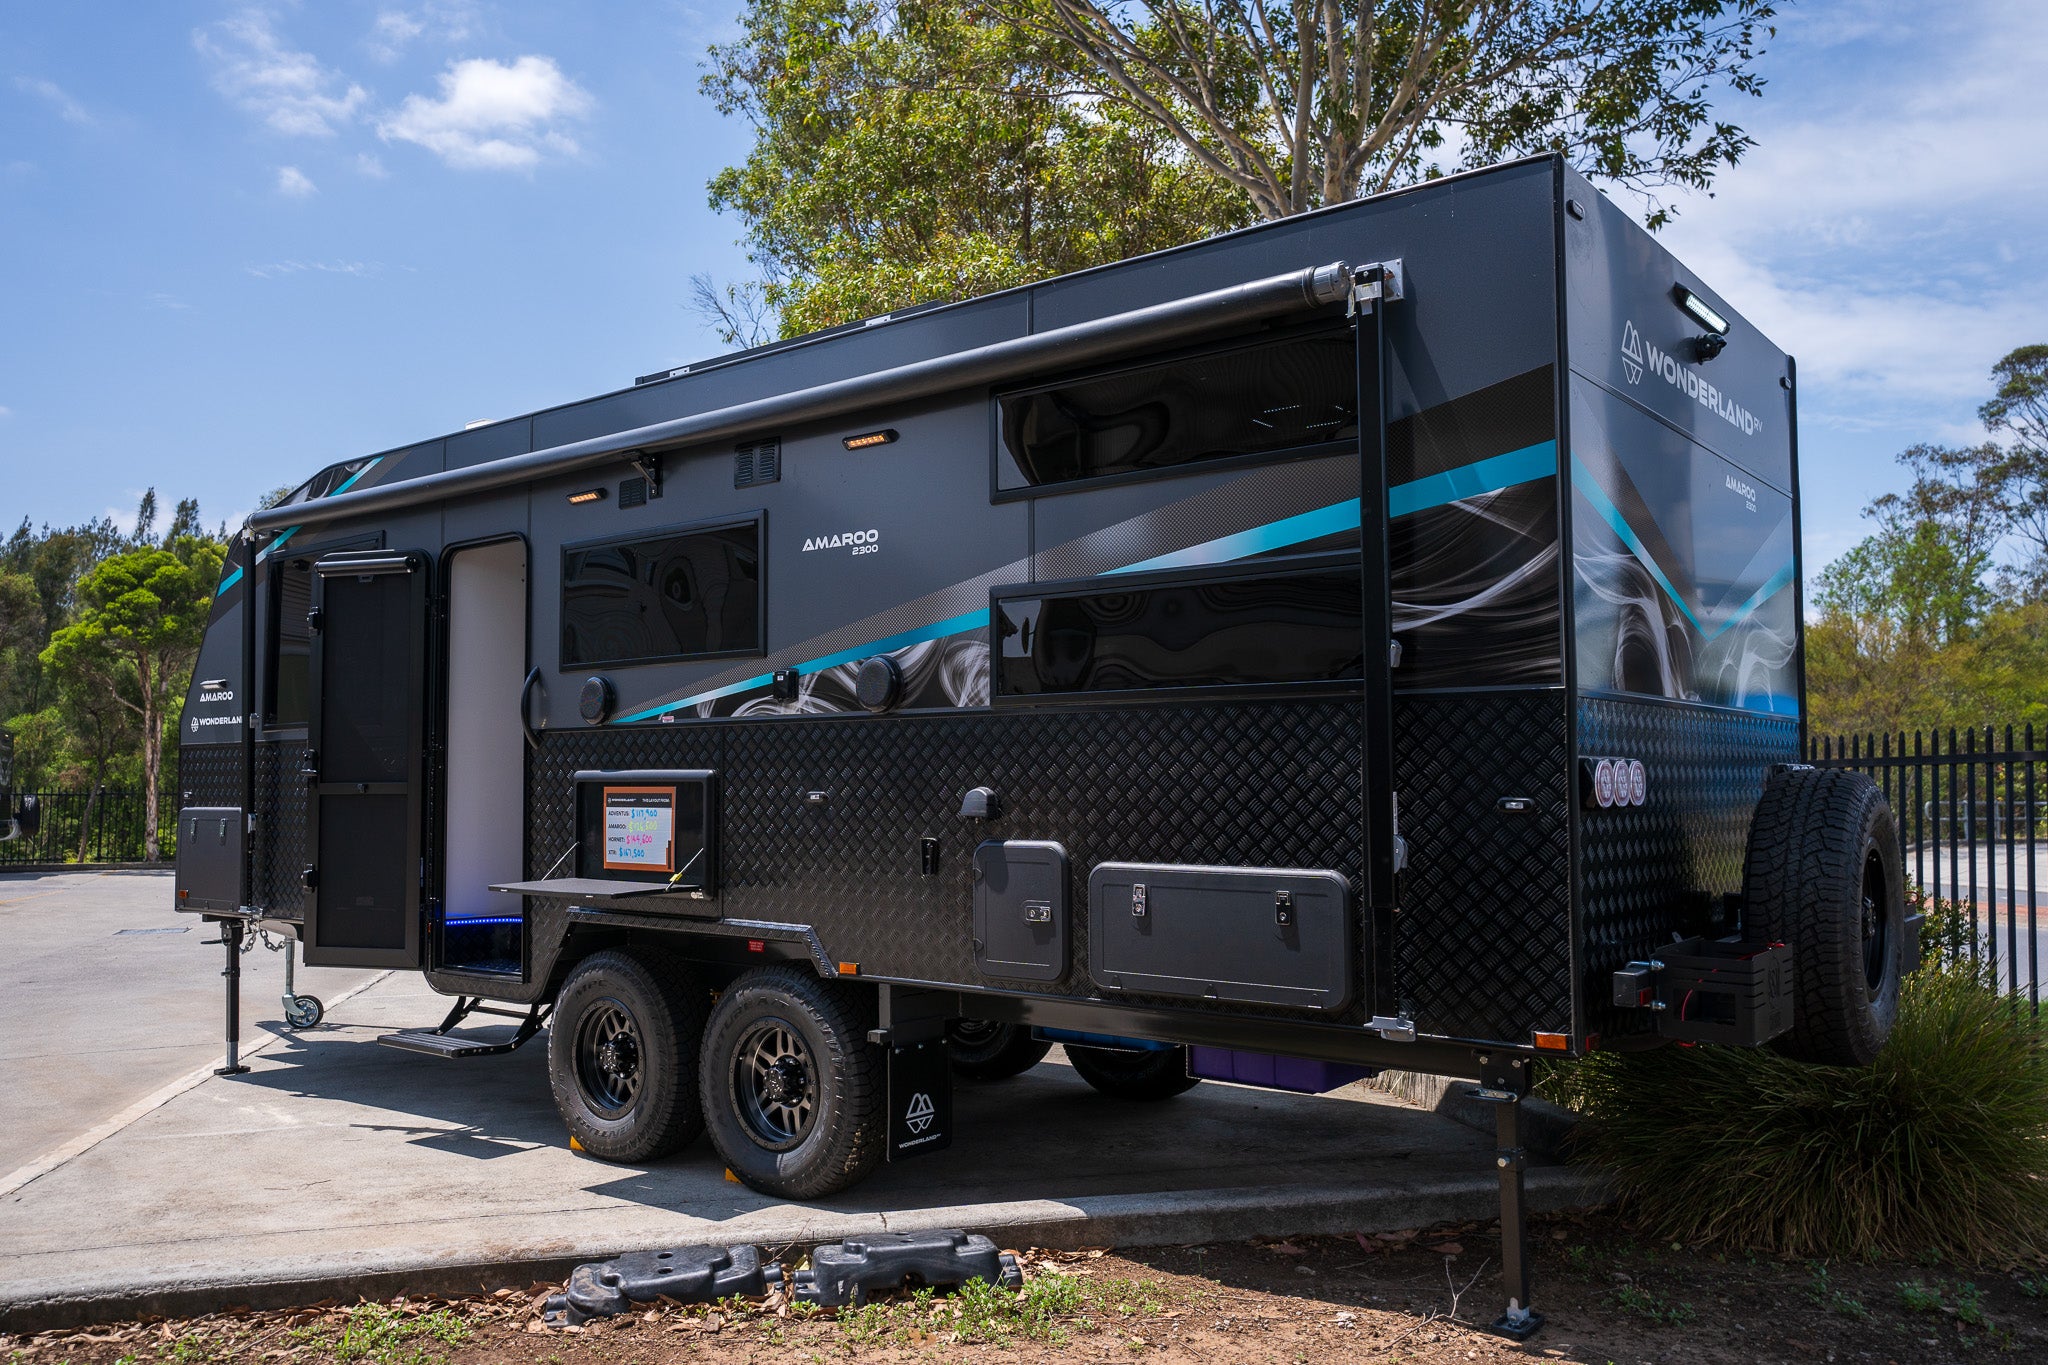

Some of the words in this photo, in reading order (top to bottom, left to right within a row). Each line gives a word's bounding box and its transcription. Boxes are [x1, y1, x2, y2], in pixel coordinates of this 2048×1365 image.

[1645, 340, 1754, 436] WONDERLAND
[1725, 474, 1756, 502] AMAROO
[801, 529, 879, 552] AMAROO
[851, 544, 879, 556] 2300
[200, 691, 234, 702] AMAROO
[199, 716, 242, 726] WONDERLAN
[898, 1134, 937, 1149] WONDERLAND
